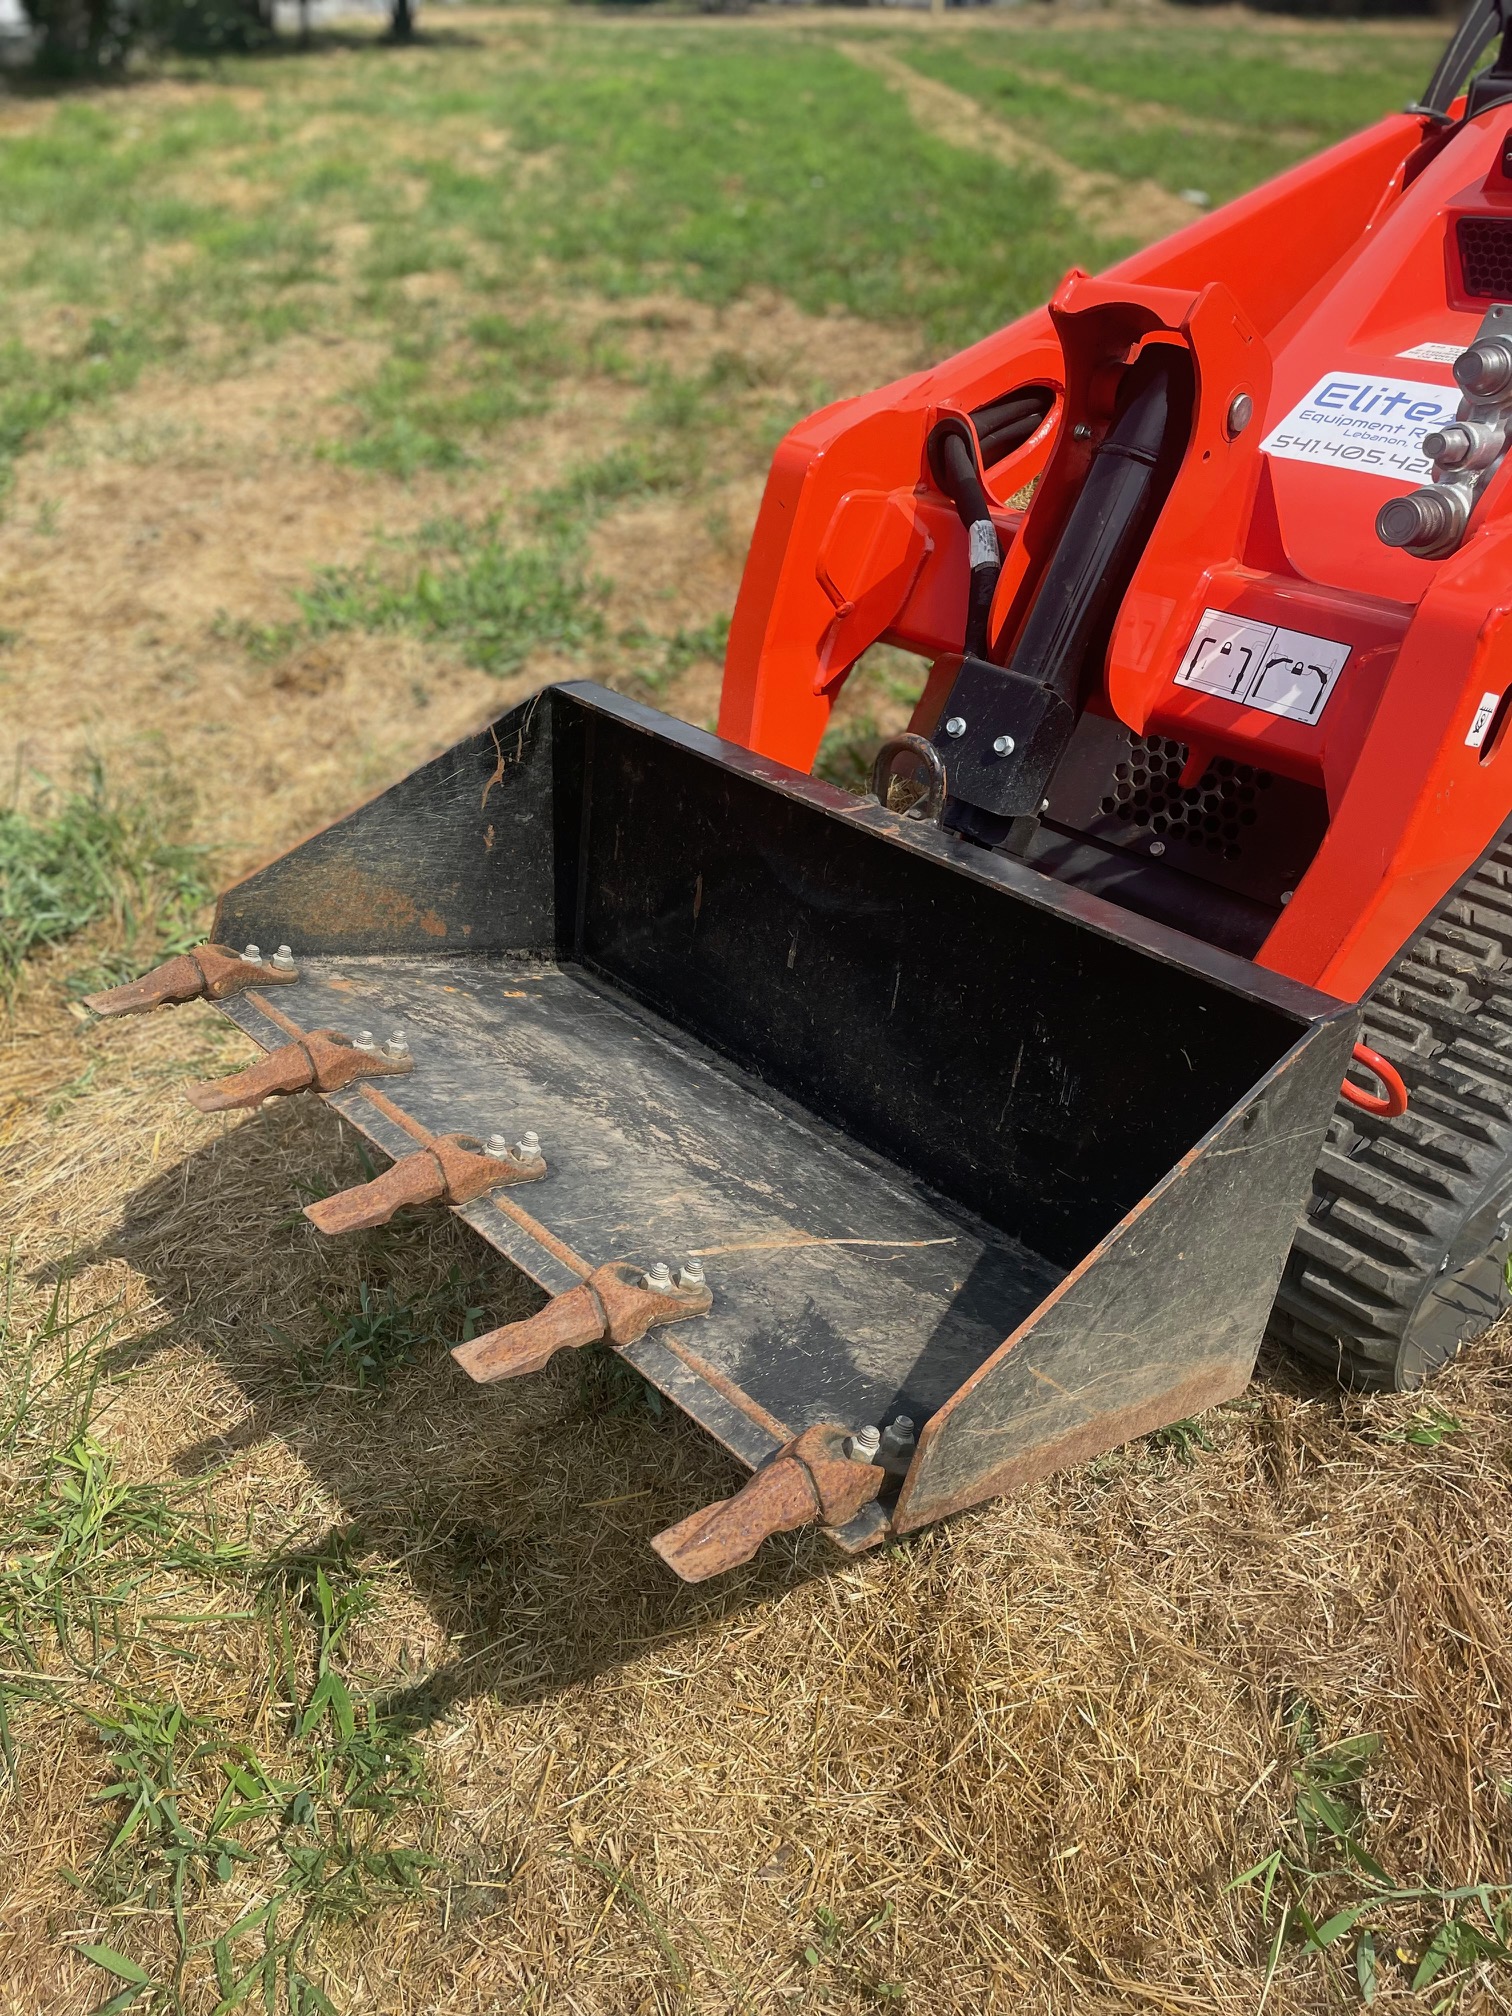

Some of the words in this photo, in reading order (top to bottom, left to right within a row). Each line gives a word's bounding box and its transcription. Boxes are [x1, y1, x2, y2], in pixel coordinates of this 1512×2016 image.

[1313, 382, 1443, 422] Elite
[1299, 409, 1406, 434] Equipment
[1407, 427, 1428, 439] R
[1342, 428, 1408, 448] Lebanon,
